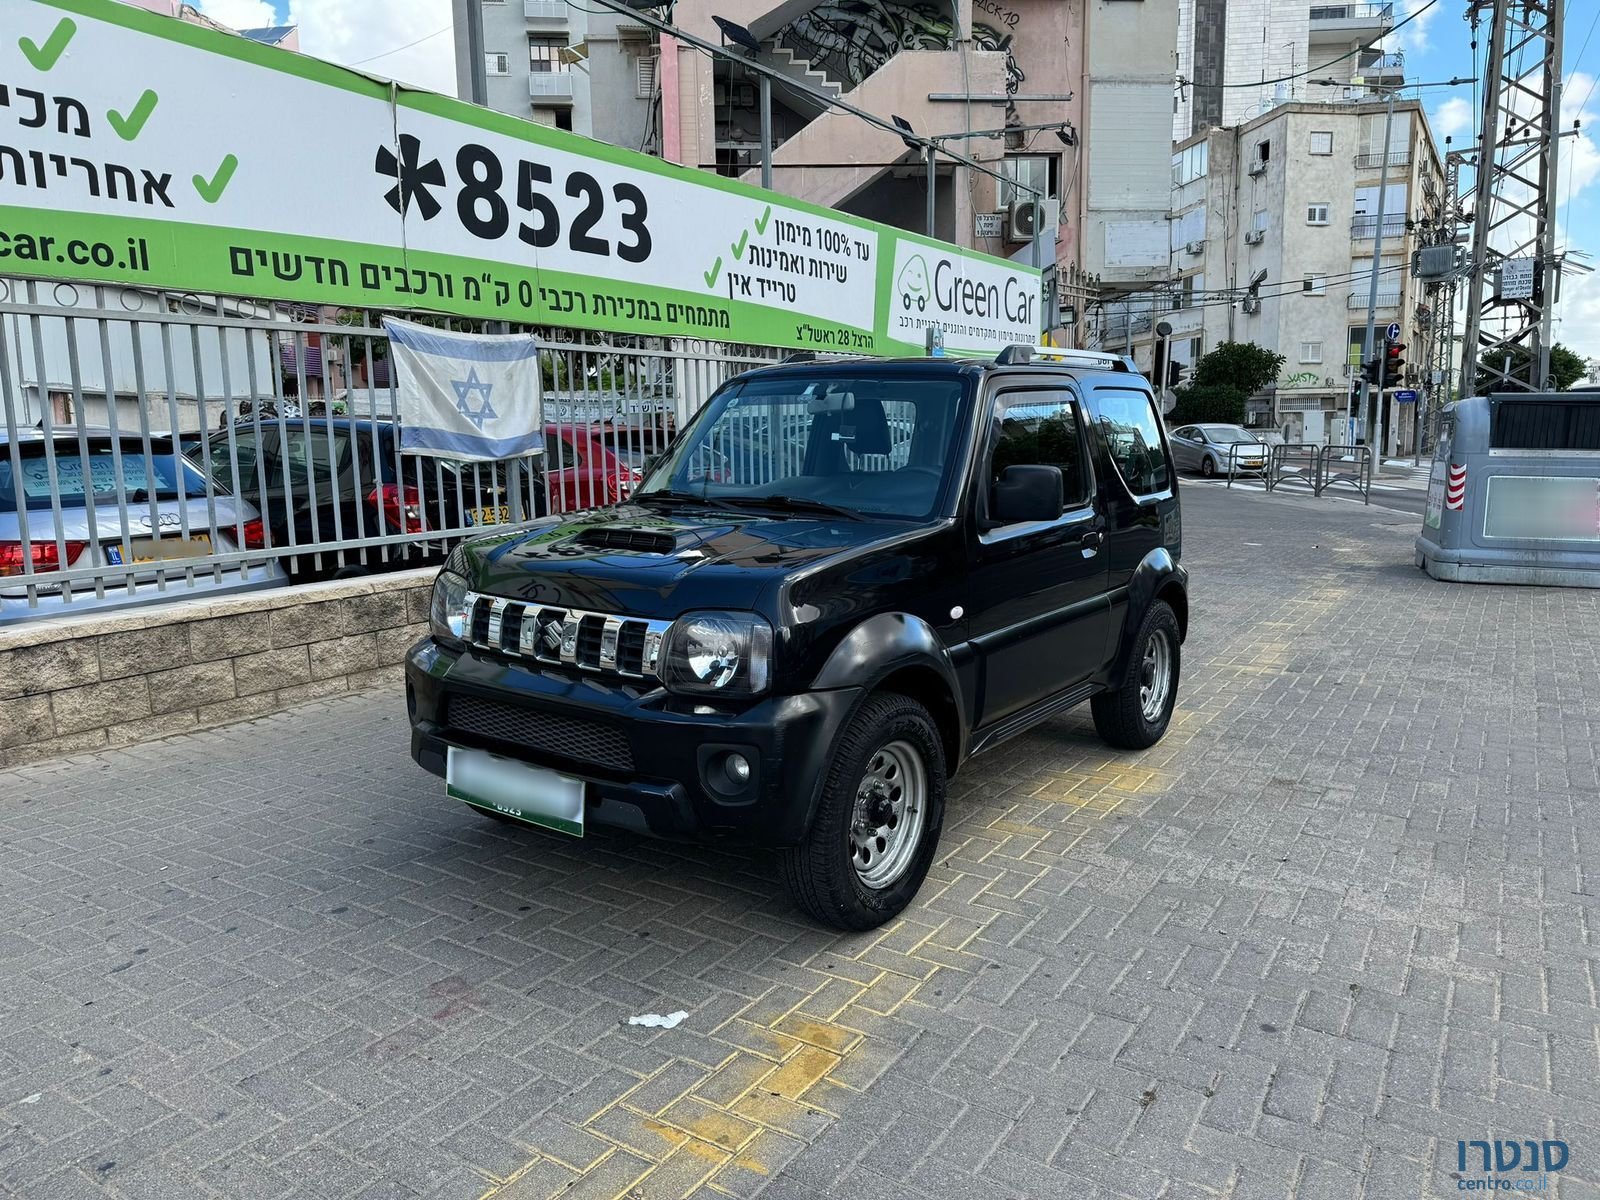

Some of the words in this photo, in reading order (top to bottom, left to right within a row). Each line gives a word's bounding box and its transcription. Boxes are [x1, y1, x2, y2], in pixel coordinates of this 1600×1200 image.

[775, 219, 812, 247] מימון
[816, 228, 851, 257] 100%
[749, 244, 804, 275] ואמינות
[854, 241, 869, 261] עד
[229, 246, 349, 287] חדשים
[809, 258, 847, 283] שירות
[360, 262, 454, 298] ורכבים
[728, 273, 751, 300] אין
[757, 278, 796, 303] טרייד
[934, 259, 999, 319] Green
[1004, 276, 1035, 325] Car
[539, 288, 587, 314] רכבי
[592, 294, 662, 321] במכירת
[666, 302, 730, 329] מתמחים
[899, 316, 914, 328] רכב
[796, 323, 836, 344] ראשל"צ
[837, 328, 850, 346] 28
[852, 330, 873, 349] הרצל
[968, 326, 997, 340] מתקדמים
[998, 330, 1014, 342] מימון
